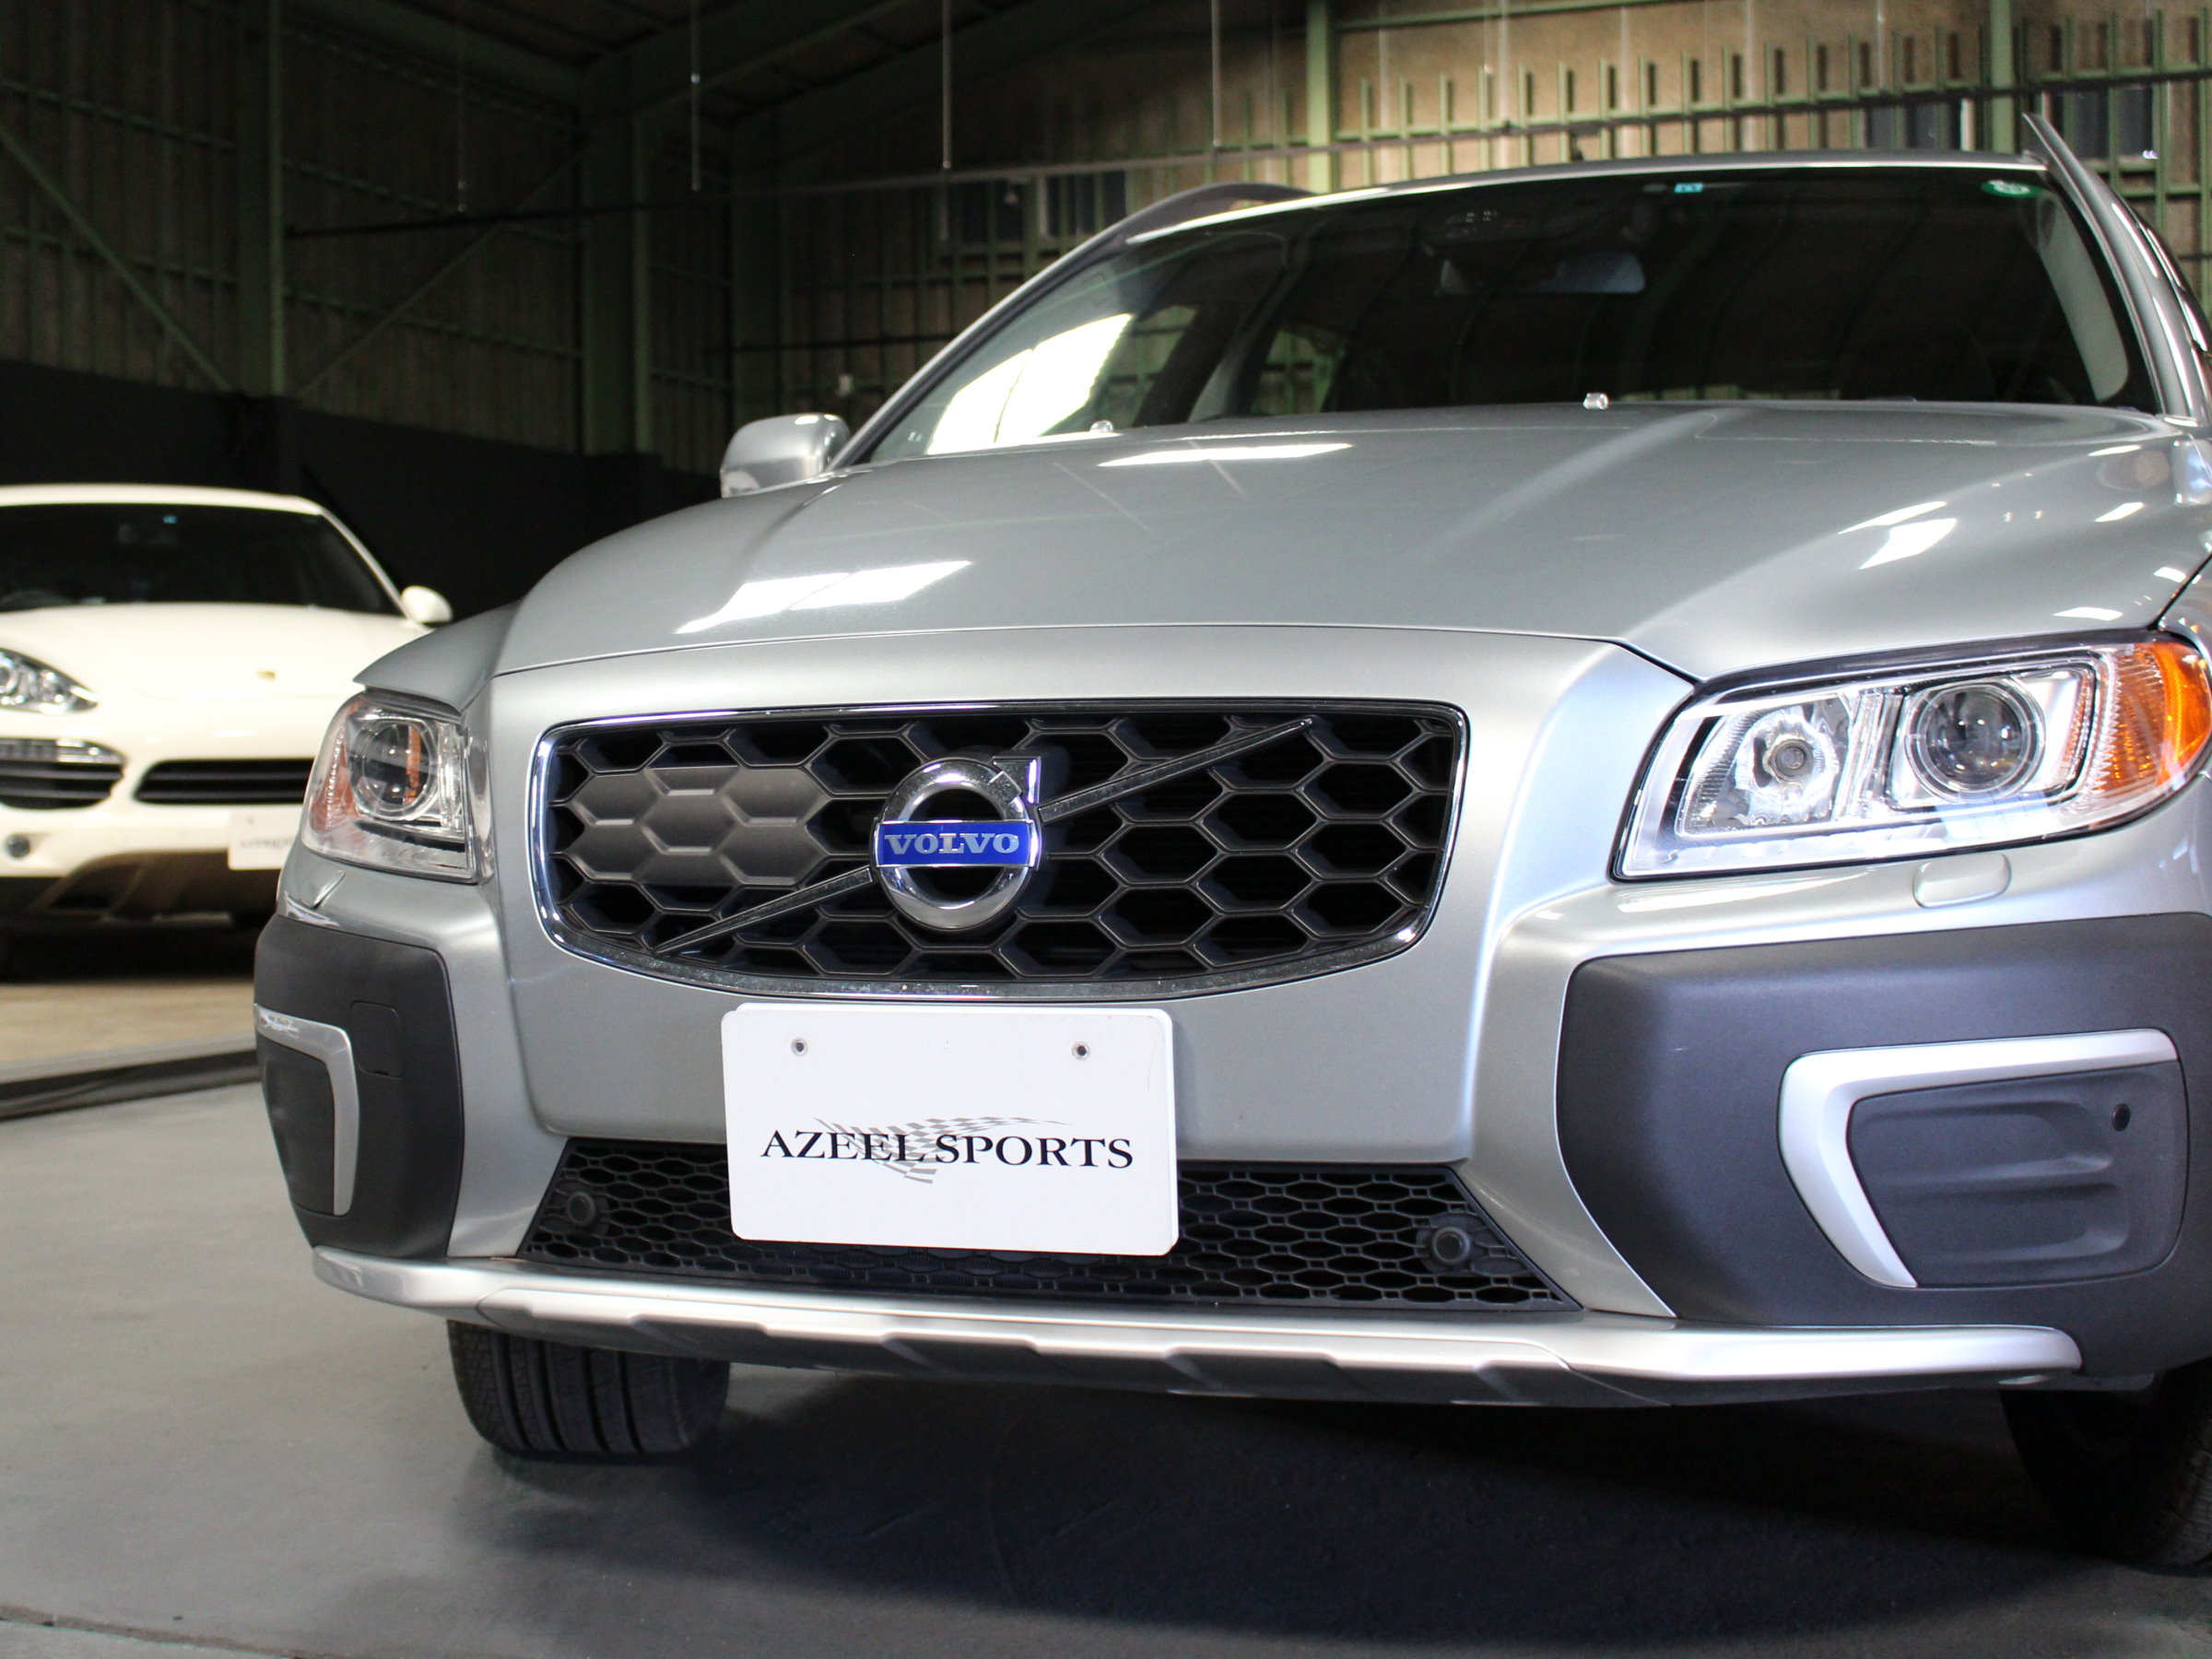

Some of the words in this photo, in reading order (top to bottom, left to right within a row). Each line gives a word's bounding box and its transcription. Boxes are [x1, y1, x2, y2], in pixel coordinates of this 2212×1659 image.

[884, 832, 1020, 854] VOLVO
[760, 1130, 925, 1162] AZEEL
[935, 1134, 1134, 1169] SPORTS
